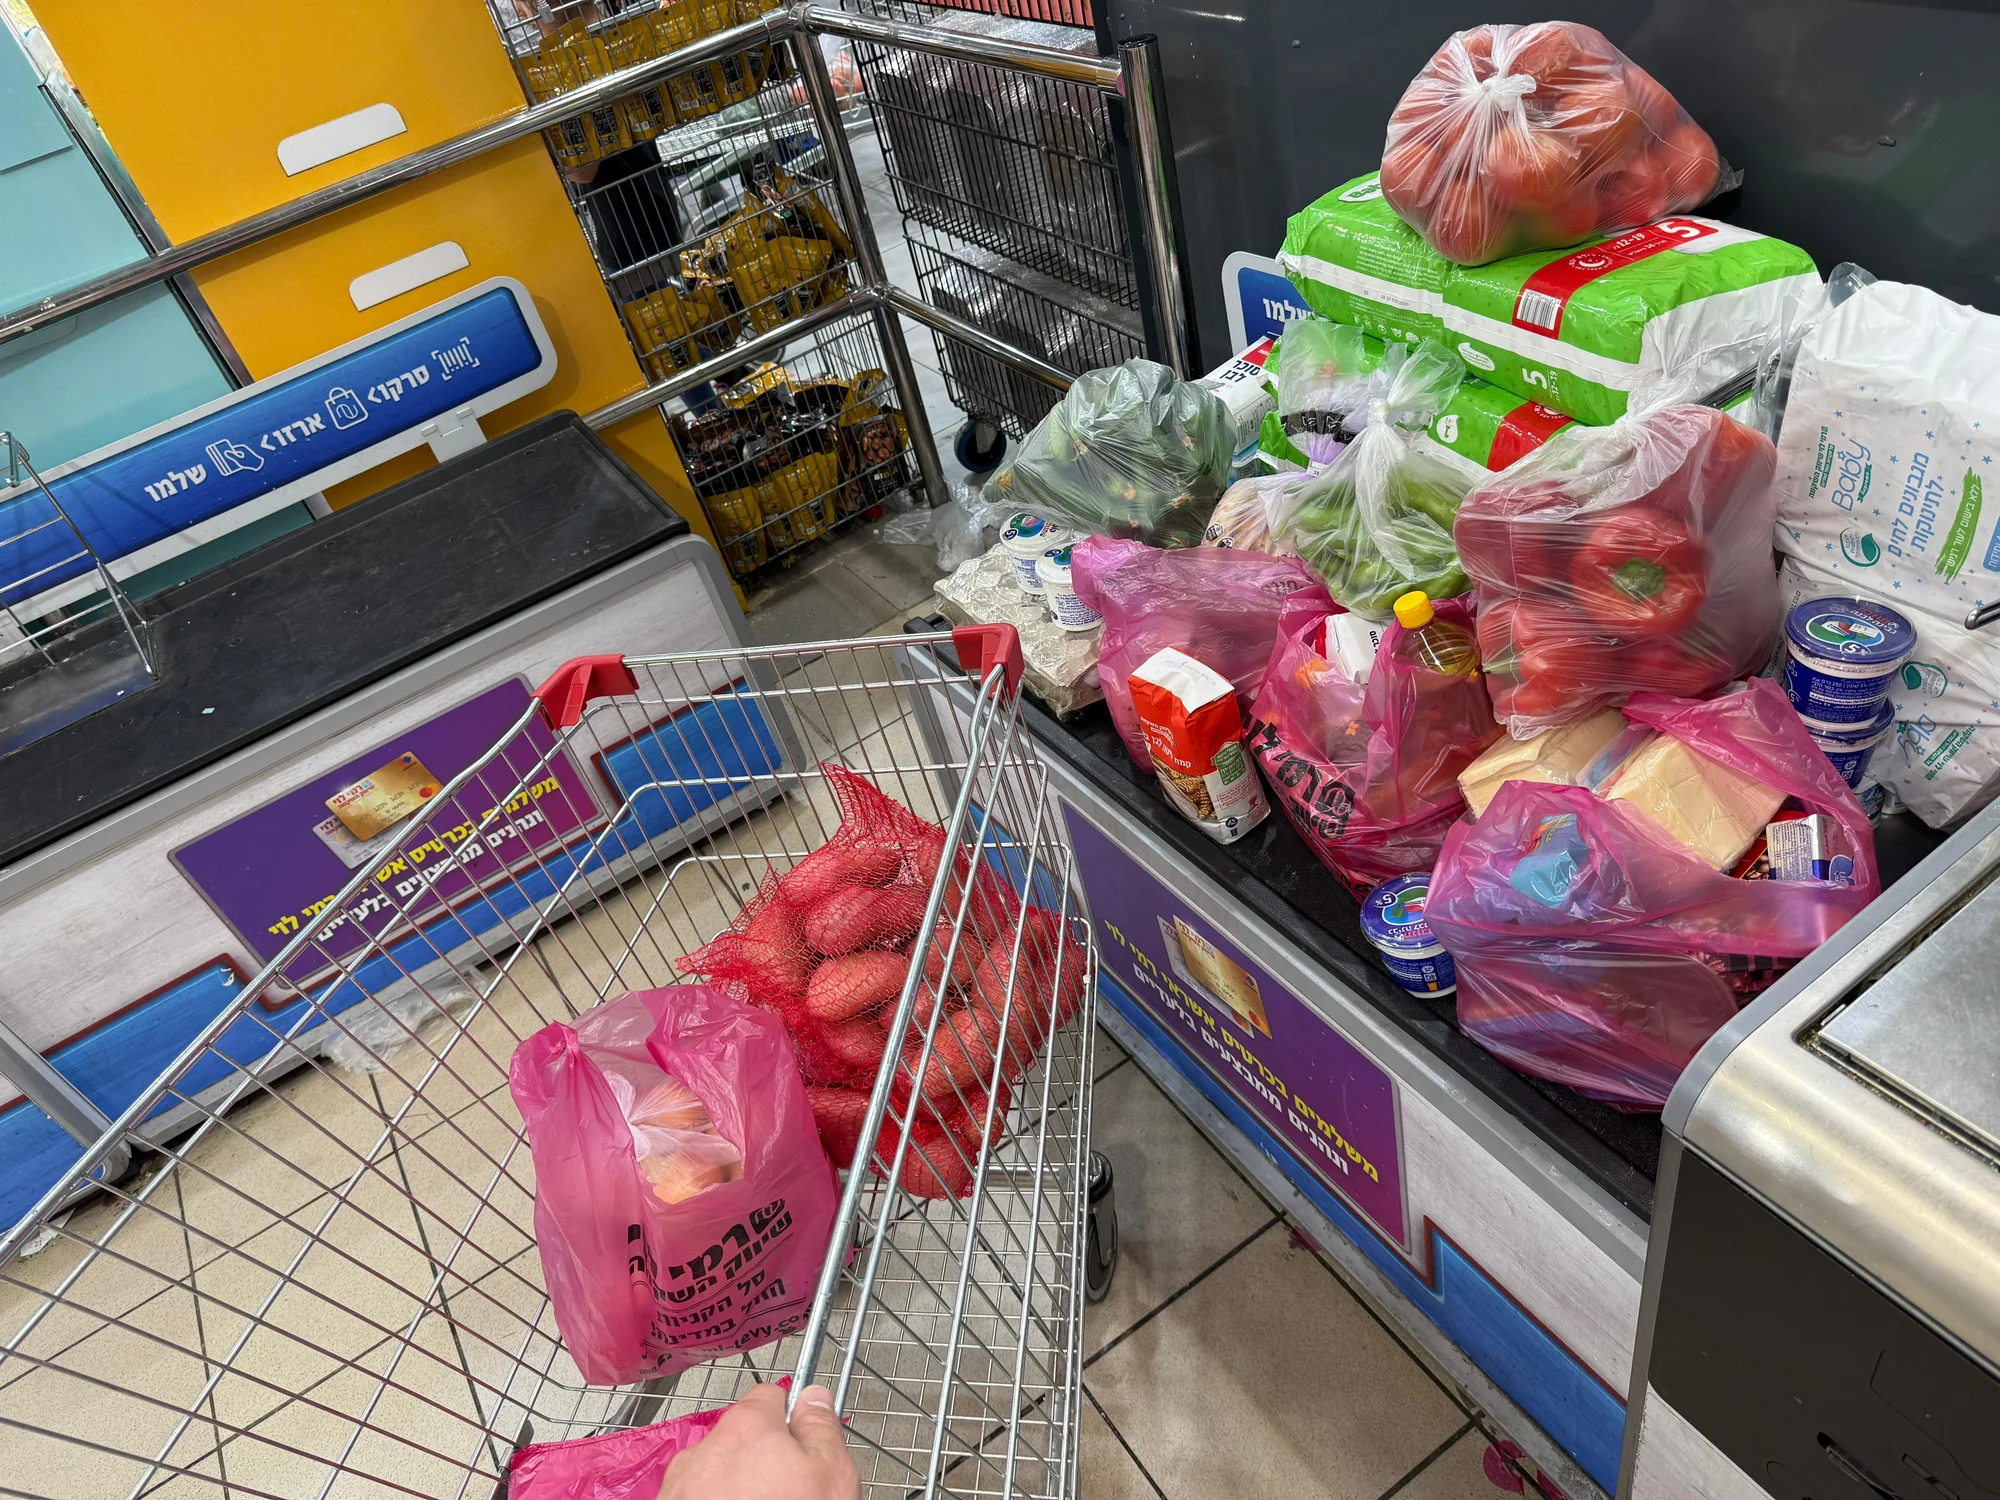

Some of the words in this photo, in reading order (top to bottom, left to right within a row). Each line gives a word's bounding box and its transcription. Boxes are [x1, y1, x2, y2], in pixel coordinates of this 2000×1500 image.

[1616, 232, 1646, 248] 12-19
[1656, 221, 1701, 238] 5
[1219, 369, 1247, 384] לבן
[1232, 359, 1261, 376] סוכר
[1521, 367, 1548, 390] 5
[377, 365, 431, 403] סרקו
[271, 412, 327, 449] ארזו
[1814, 451, 1825, 472] שיווק
[1831, 438, 1872, 512] Baby
[144, 463, 208, 503] שלמו
[1808, 471, 1820, 499] השקמה
[1860, 471, 1872, 496] Supreme
[1898, 451, 1930, 517] מגבונים
[1968, 483, 1981, 502] ללא
[1910, 478, 1945, 553] לתינוקות
[1960, 502, 1976, 528] בישום
[1887, 517, 1909, 558] לחים
[1952, 527, 1967, 546] לעור
[1946, 547, 1961, 568] רגיש
[1369, 630, 1380, 648] סוכר
[1843, 643, 1870, 657] 5%
[1374, 893, 1393, 907] 5%
[268, 915, 299, 935] לוי
[1103, 918, 1126, 947] לוי
[1128, 940, 1159, 978] רמי
[1132, 962, 1198, 1034] בלעדיים
[1161, 970, 1217, 1033] אשראי
[1200, 1025, 1284, 1114] ממבצעים
[1220, 1025, 1290, 1101] בכרטיס
[1287, 1107, 1350, 1177] ונהנים
[1293, 1093, 1380, 1184] משלמים
[668, 1222, 751, 1281] רמי
[723, 1210, 794, 1281] שיווק
[736, 1268, 766, 1297] סל
[656, 1295, 734, 1328] הקניות
[650, 1317, 737, 1345] במדינה!
